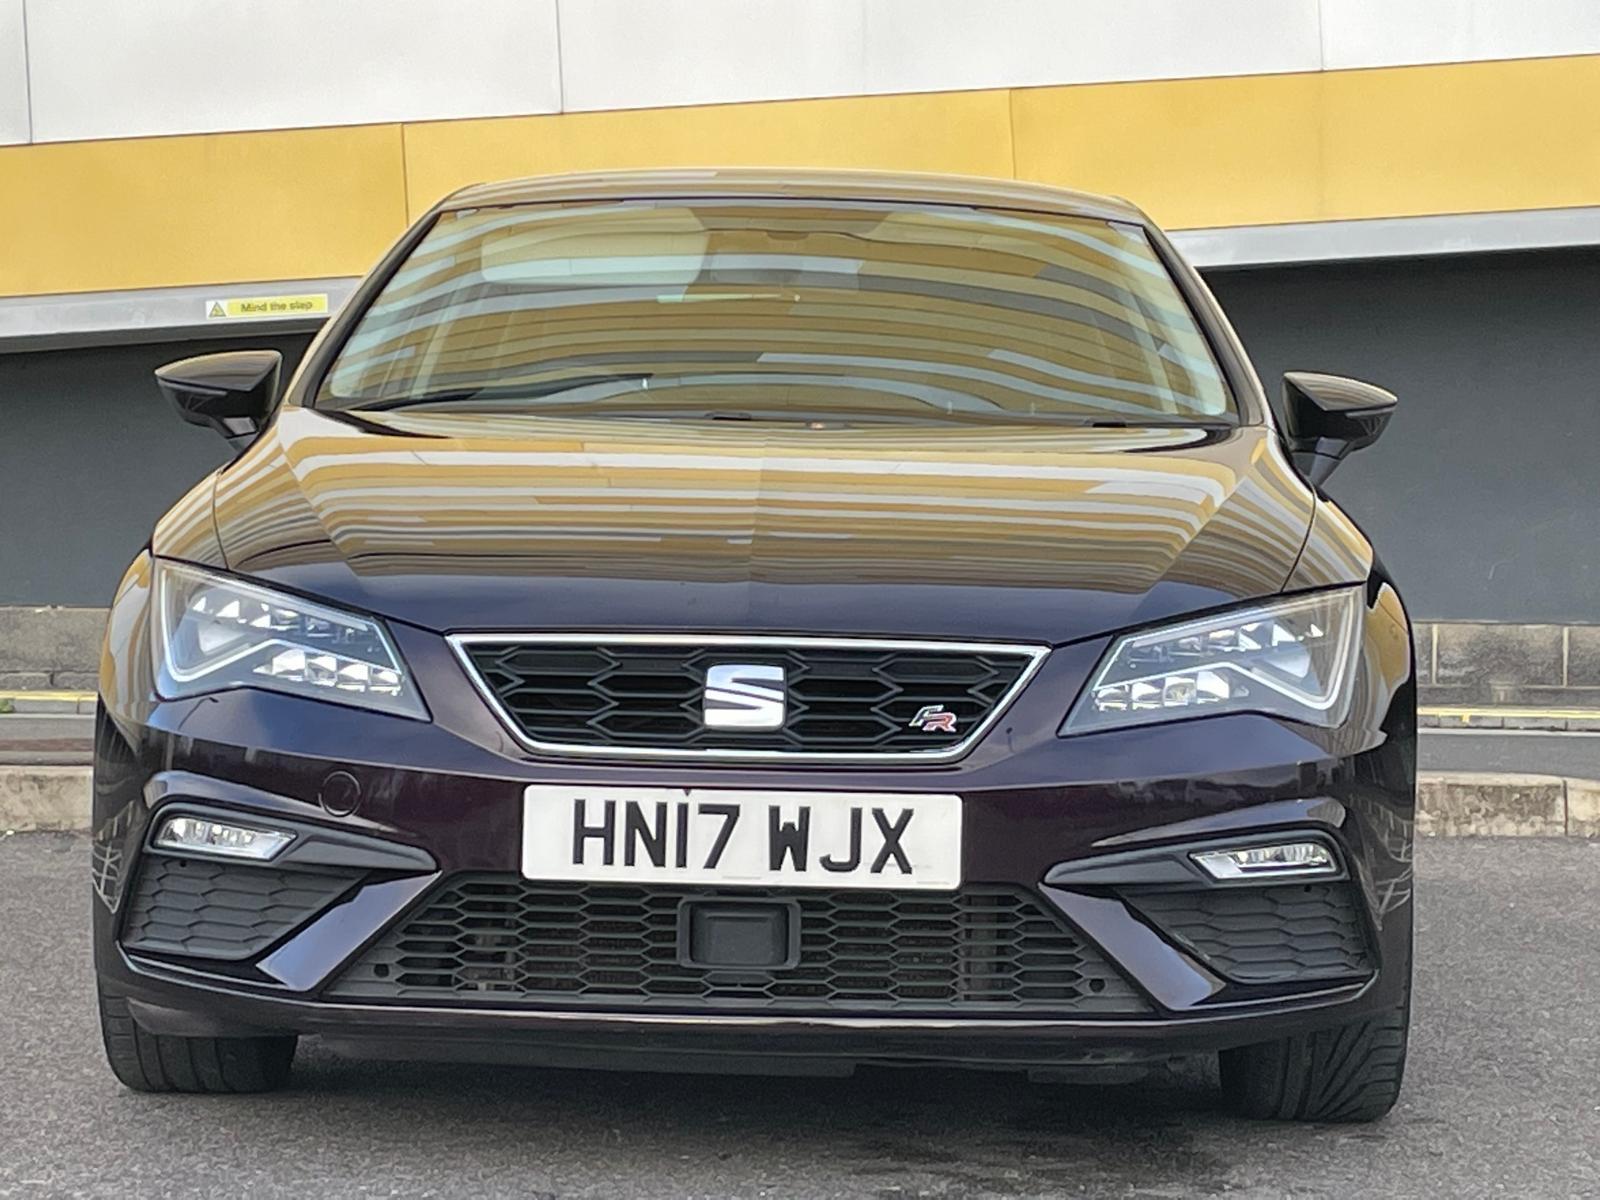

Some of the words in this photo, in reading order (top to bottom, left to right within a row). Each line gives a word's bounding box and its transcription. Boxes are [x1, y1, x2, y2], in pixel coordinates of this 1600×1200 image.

[240, 302, 267, 312] Mind
[269, 301, 287, 311] the
[908, 704, 957, 732] FR
[572, 799, 741, 869] HN17
[767, 805, 915, 875] WJX
